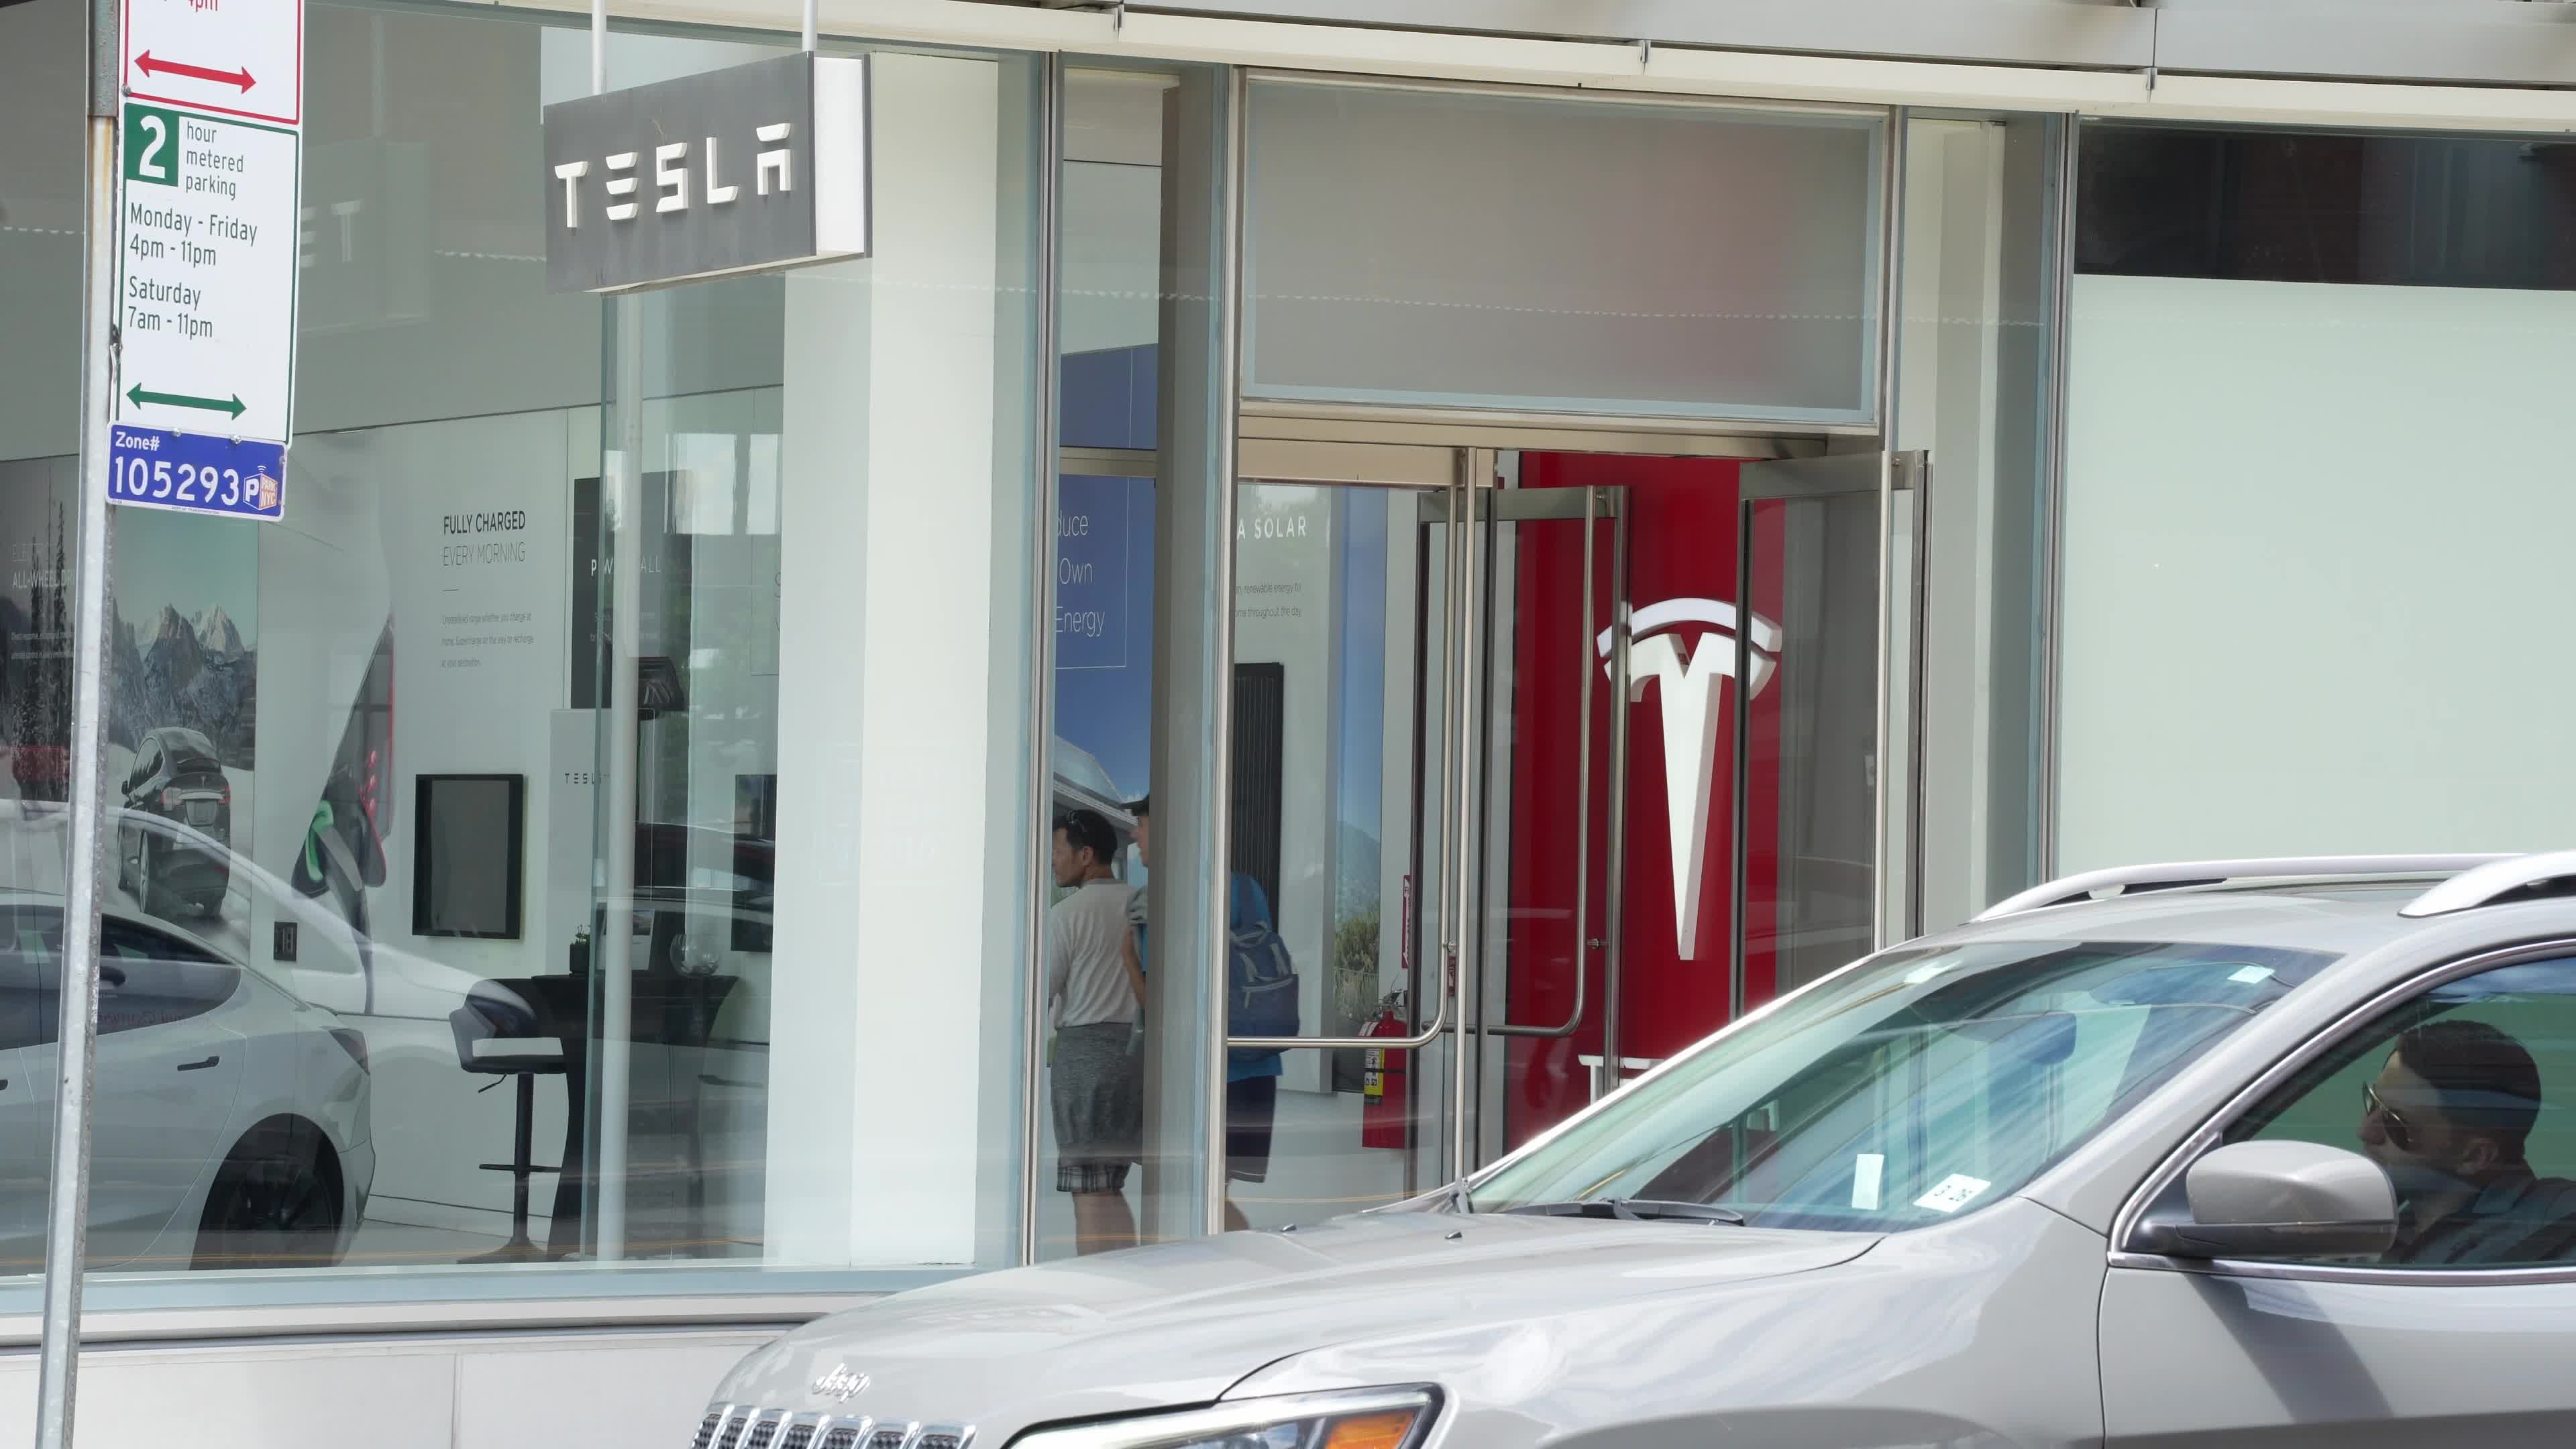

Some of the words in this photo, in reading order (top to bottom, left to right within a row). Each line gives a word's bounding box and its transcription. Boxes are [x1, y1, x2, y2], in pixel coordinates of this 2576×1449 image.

[187, 121, 217, 143] hour
[139, 115, 166, 179] 2
[186, 150, 244, 172] metered
[186, 175, 236, 201] parking
[554, 122, 792, 228] TESLA
[130, 202, 193, 237] Monday
[209, 214, 258, 246] Friday
[129, 233, 164, 261] 4pm
[181, 241, 216, 268] 11pm
[129, 276, 201, 311] Saturday
[128, 306, 160, 331] 7am
[178, 313, 213, 339] 11pm
[115, 431, 160, 451] Zone#
[115, 455, 239, 506] 105293
[443, 515, 473, 535] FULLY
[476, 511, 526, 533] CHARGED
[1254, 515, 1306, 539] SOLAR
[443, 544, 474, 566] EVERY
[477, 541, 526, 564] MORNING
[1059, 557, 1093, 584] Own
[1055, 606, 1106, 638] Energy
[565, 773, 609, 784] TESL
